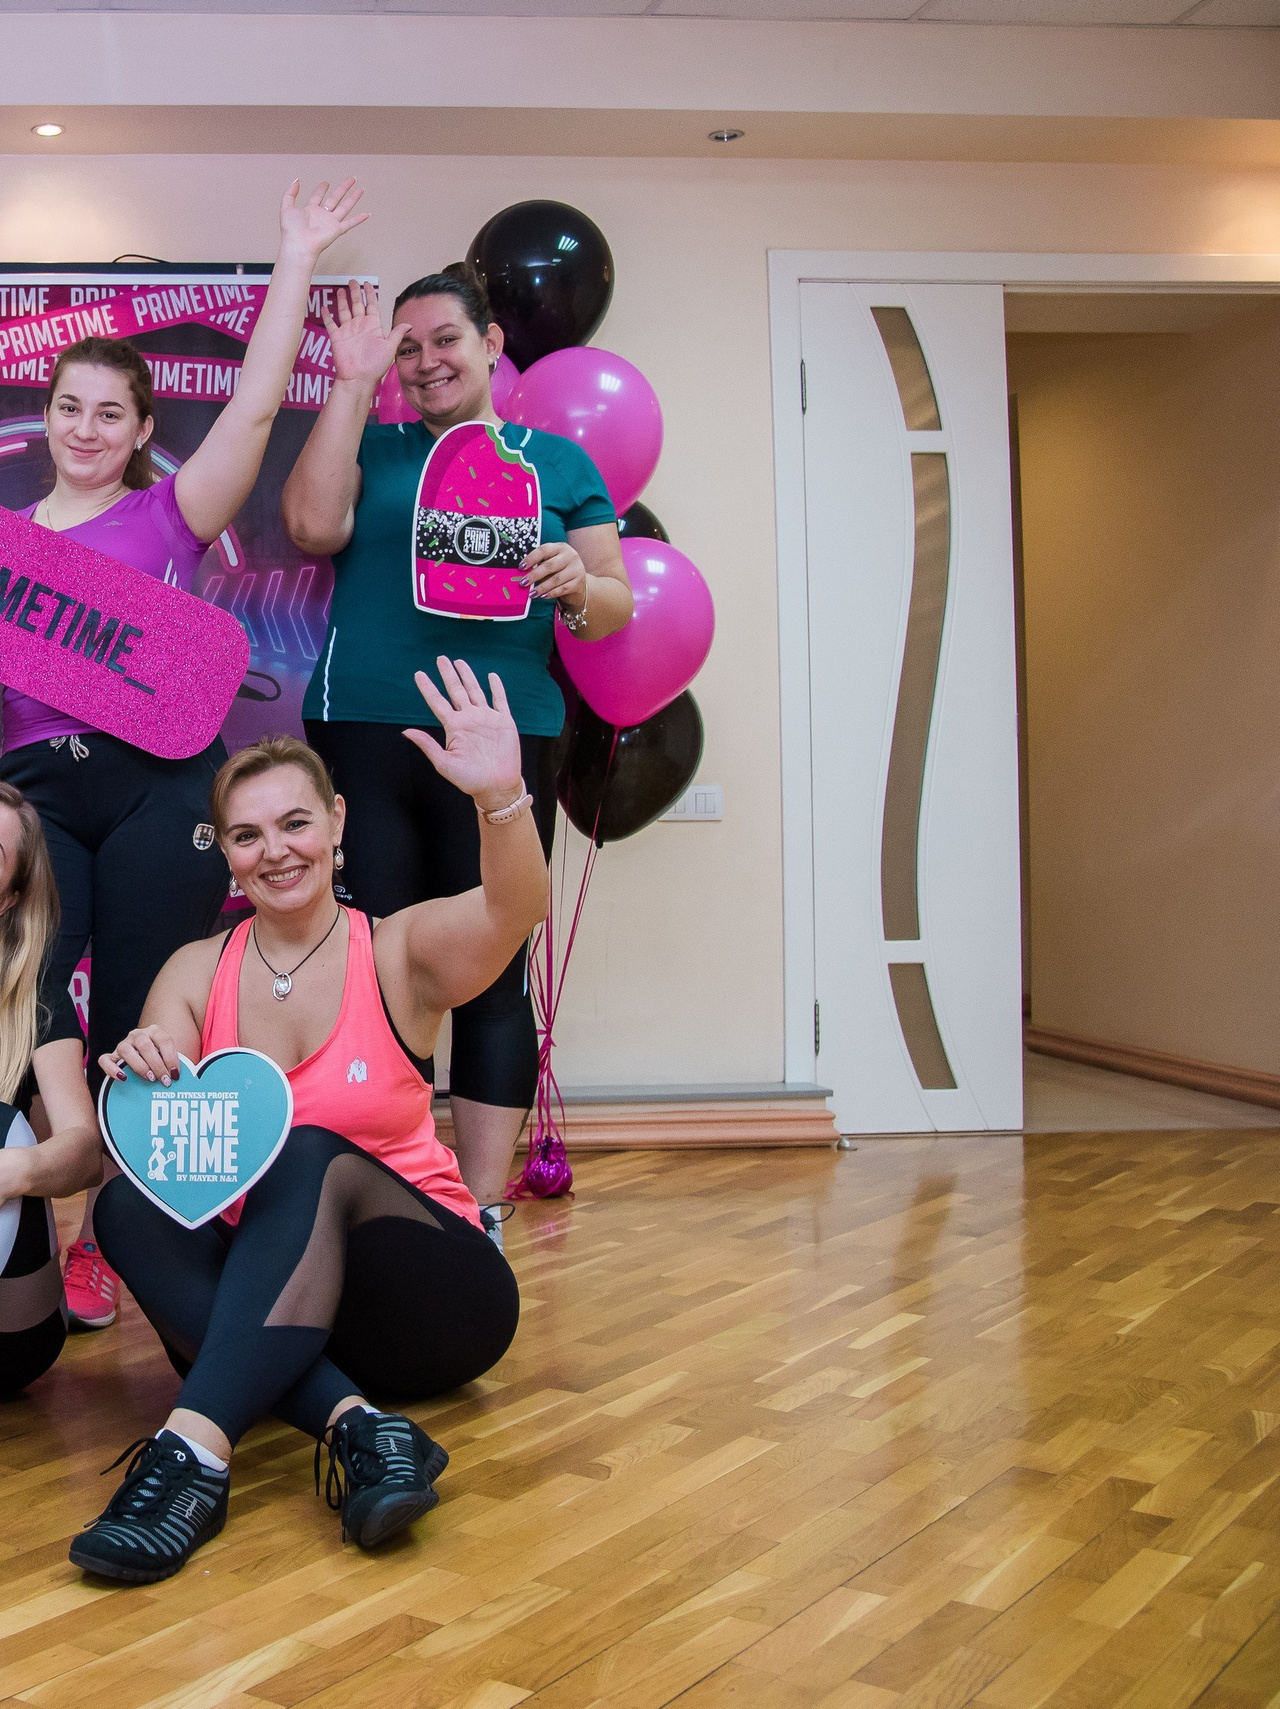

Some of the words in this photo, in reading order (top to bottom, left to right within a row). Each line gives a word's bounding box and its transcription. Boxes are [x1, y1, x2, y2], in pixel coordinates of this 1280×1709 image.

[131, 285, 255, 327] PRIMETIME
[152, 1091, 176, 1099] TREND
[207, 1092, 239, 1100] PROJECT
[173, 1136, 239, 1174] TIME
[176, 1174, 188, 1182] BY
[189, 1174, 218, 1182] MAYER
